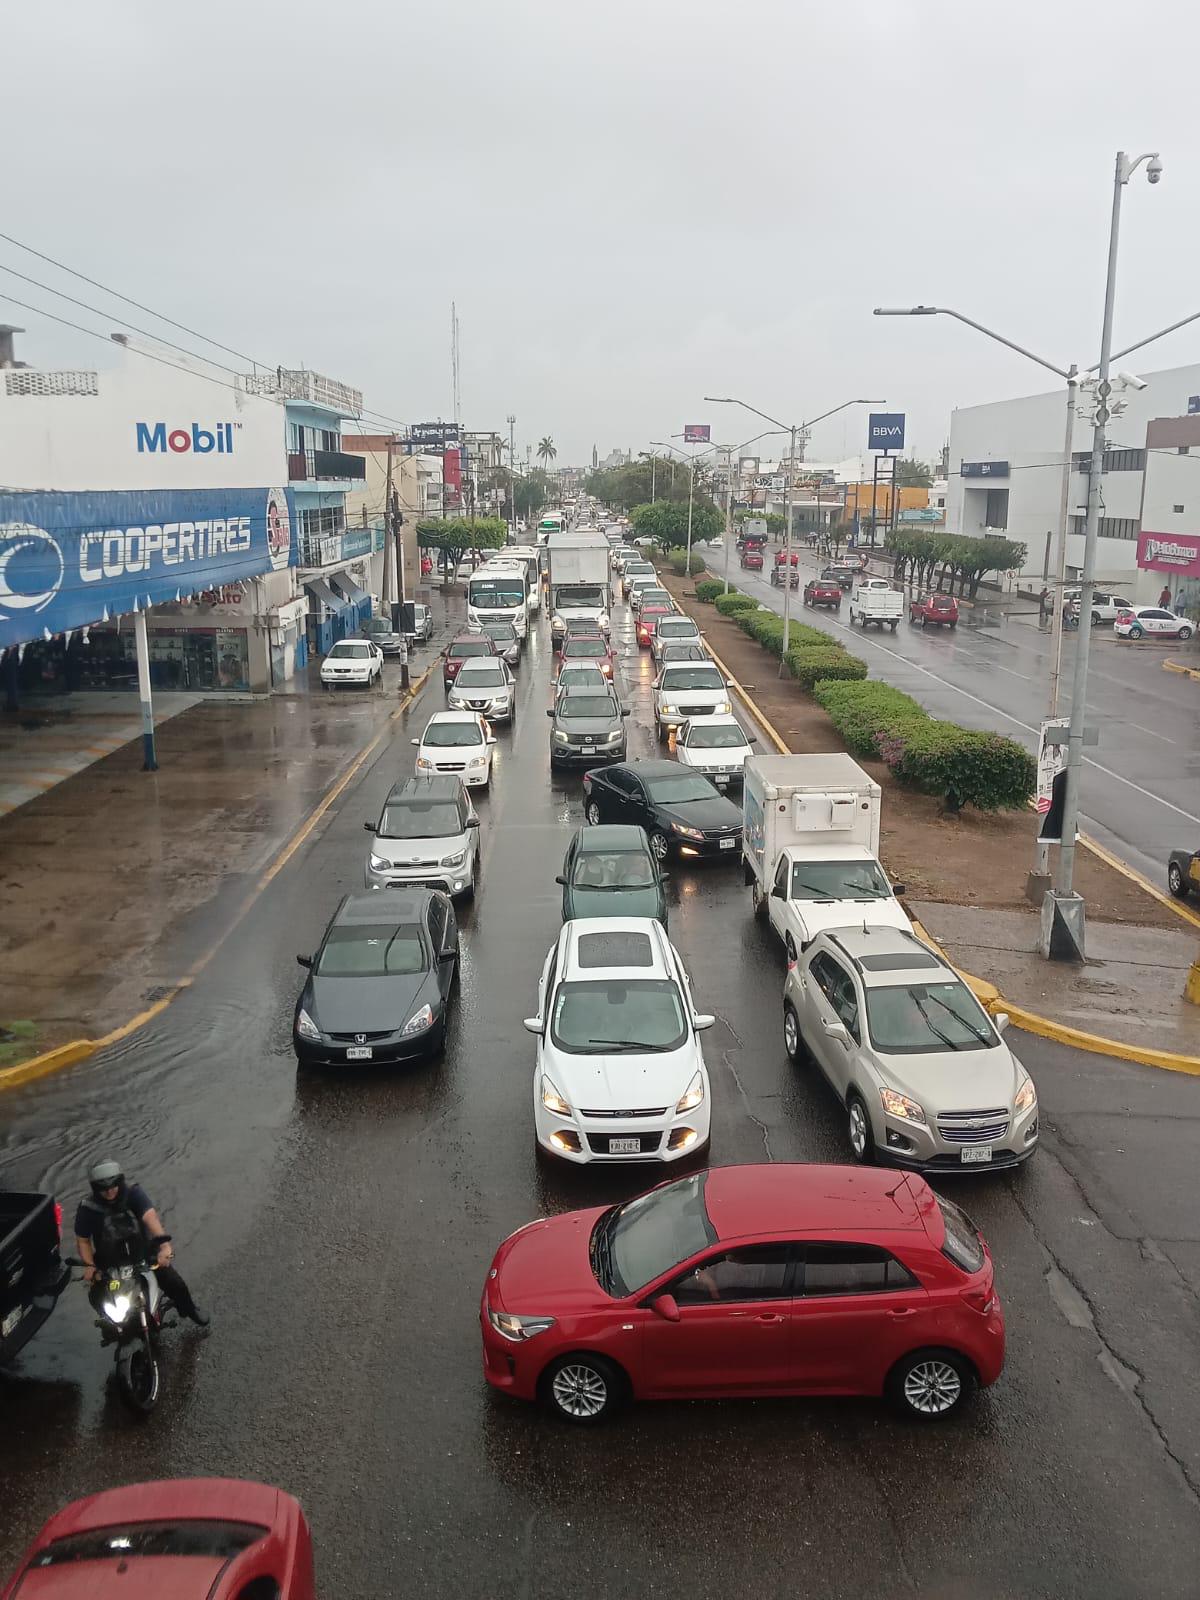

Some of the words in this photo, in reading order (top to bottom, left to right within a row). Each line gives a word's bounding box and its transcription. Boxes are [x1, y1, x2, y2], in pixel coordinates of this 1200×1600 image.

[136, 422, 233, 453] Mobil
[873, 426, 902, 436] BBVA
[79, 516, 251, 583] COOPERTIRES
